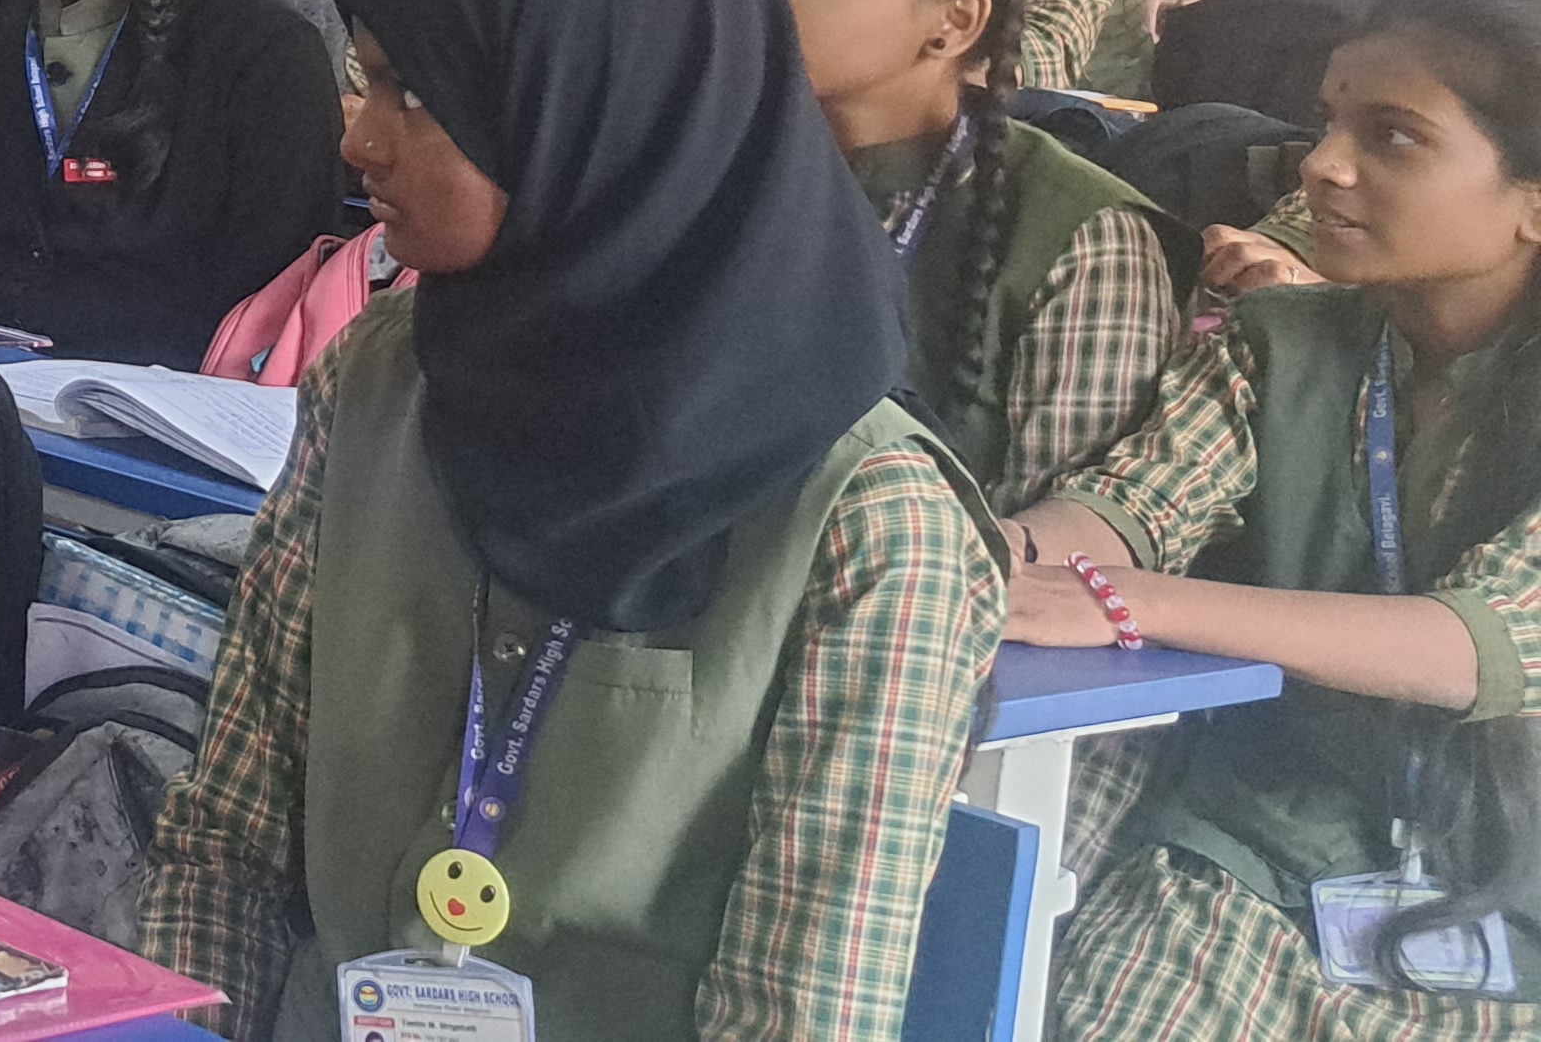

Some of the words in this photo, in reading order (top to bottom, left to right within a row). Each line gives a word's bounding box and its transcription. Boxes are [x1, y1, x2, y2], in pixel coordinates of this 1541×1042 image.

[496, 736, 524, 776] Govt.
[511, 674, 548, 734] Sardars
[535, 638, 565, 675] High
[414, 986, 457, 1005] SARDARS
[457, 988, 481, 1005] HIGH
[483, 991, 520, 1007] SCHOOL
